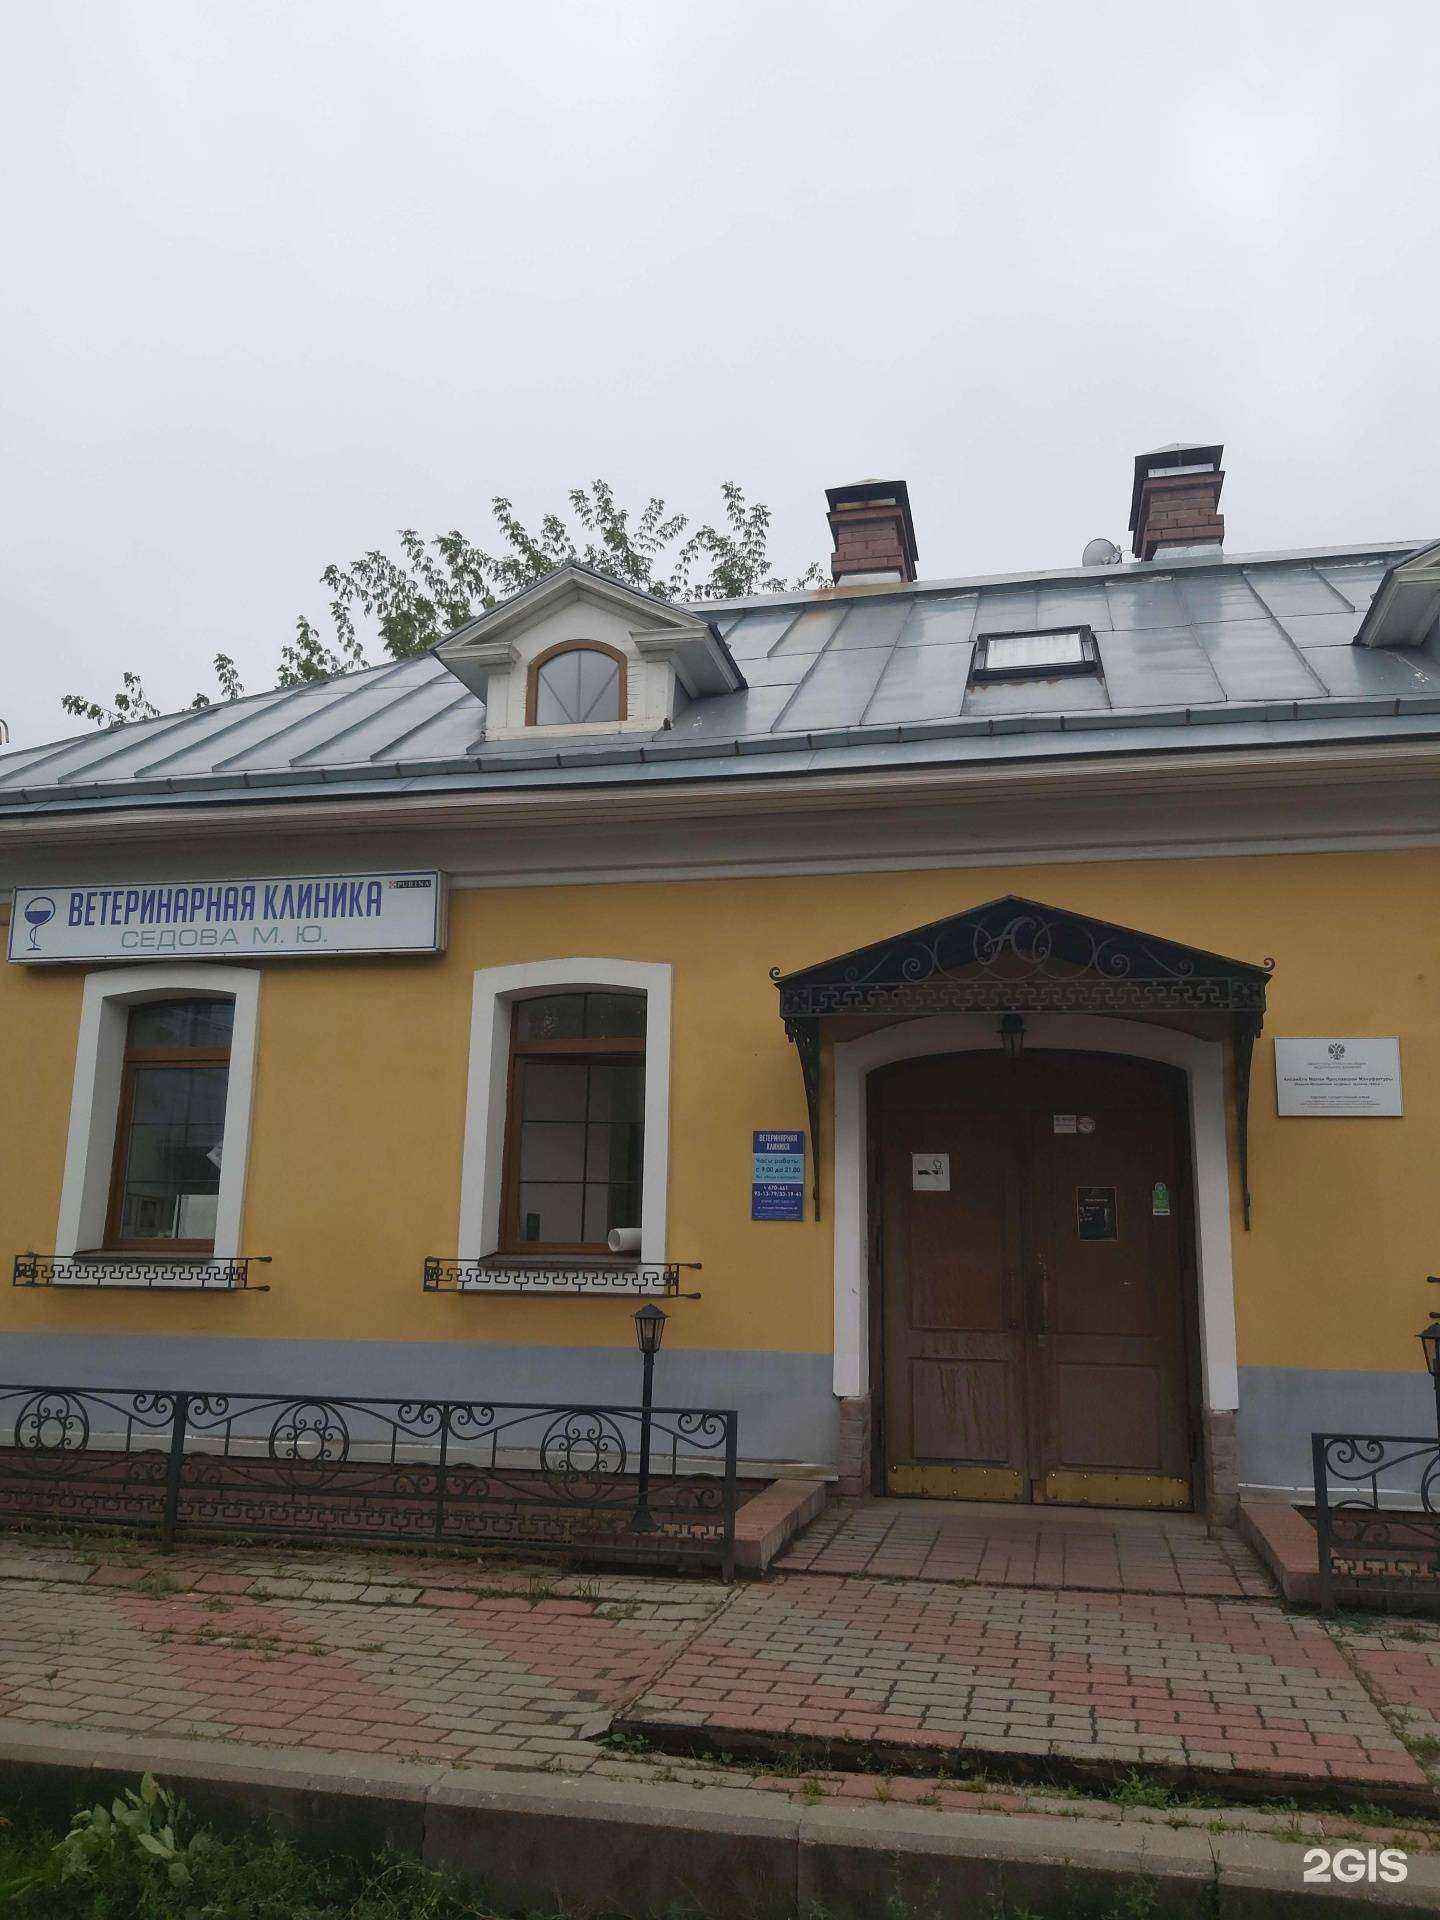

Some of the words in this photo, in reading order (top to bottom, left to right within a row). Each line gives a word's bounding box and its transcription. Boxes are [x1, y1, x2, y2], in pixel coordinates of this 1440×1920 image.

[396, 879, 432, 888] PURINA
[68, 885, 256, 926] ВЕТЕРИНАРНАЯ
[264, 880, 382, 919] КЛИНИКА
[120, 928, 240, 951] СЕДОВА
[252, 926, 285, 946] М.
[296, 924, 328, 944] Ю.
